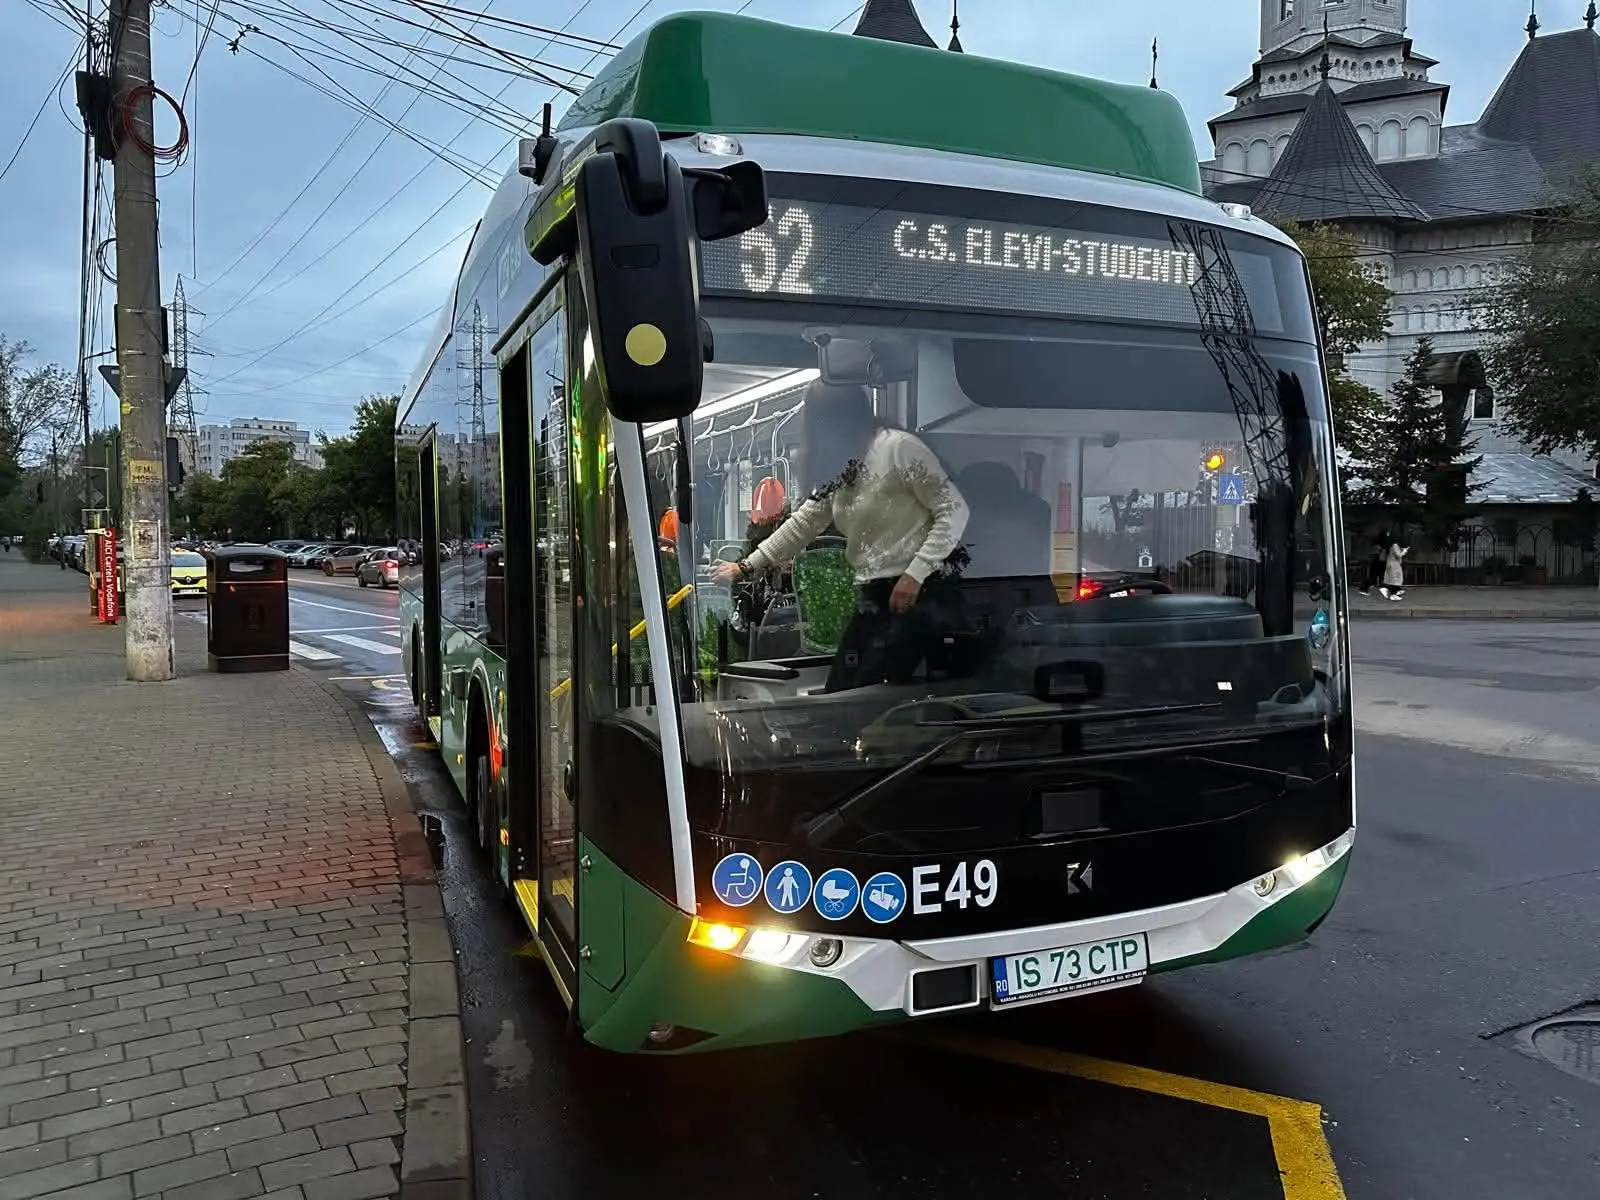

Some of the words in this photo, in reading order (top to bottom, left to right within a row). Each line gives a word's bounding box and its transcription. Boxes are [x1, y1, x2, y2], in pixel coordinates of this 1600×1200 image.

[740, 203, 812, 294] 52
[894, 219, 956, 262] C.S.
[966, 227, 1195, 285] ELEVI-STUDENTI
[105, 556, 113, 582] Cartela
[106, 583, 114, 617] Vodafone
[912, 859, 998, 915] E49
[996, 979, 1008, 993] RO
[1014, 957, 1041, 989] IS
[1050, 950, 1081, 983] 73
[1088, 939, 1138, 974] CTP
